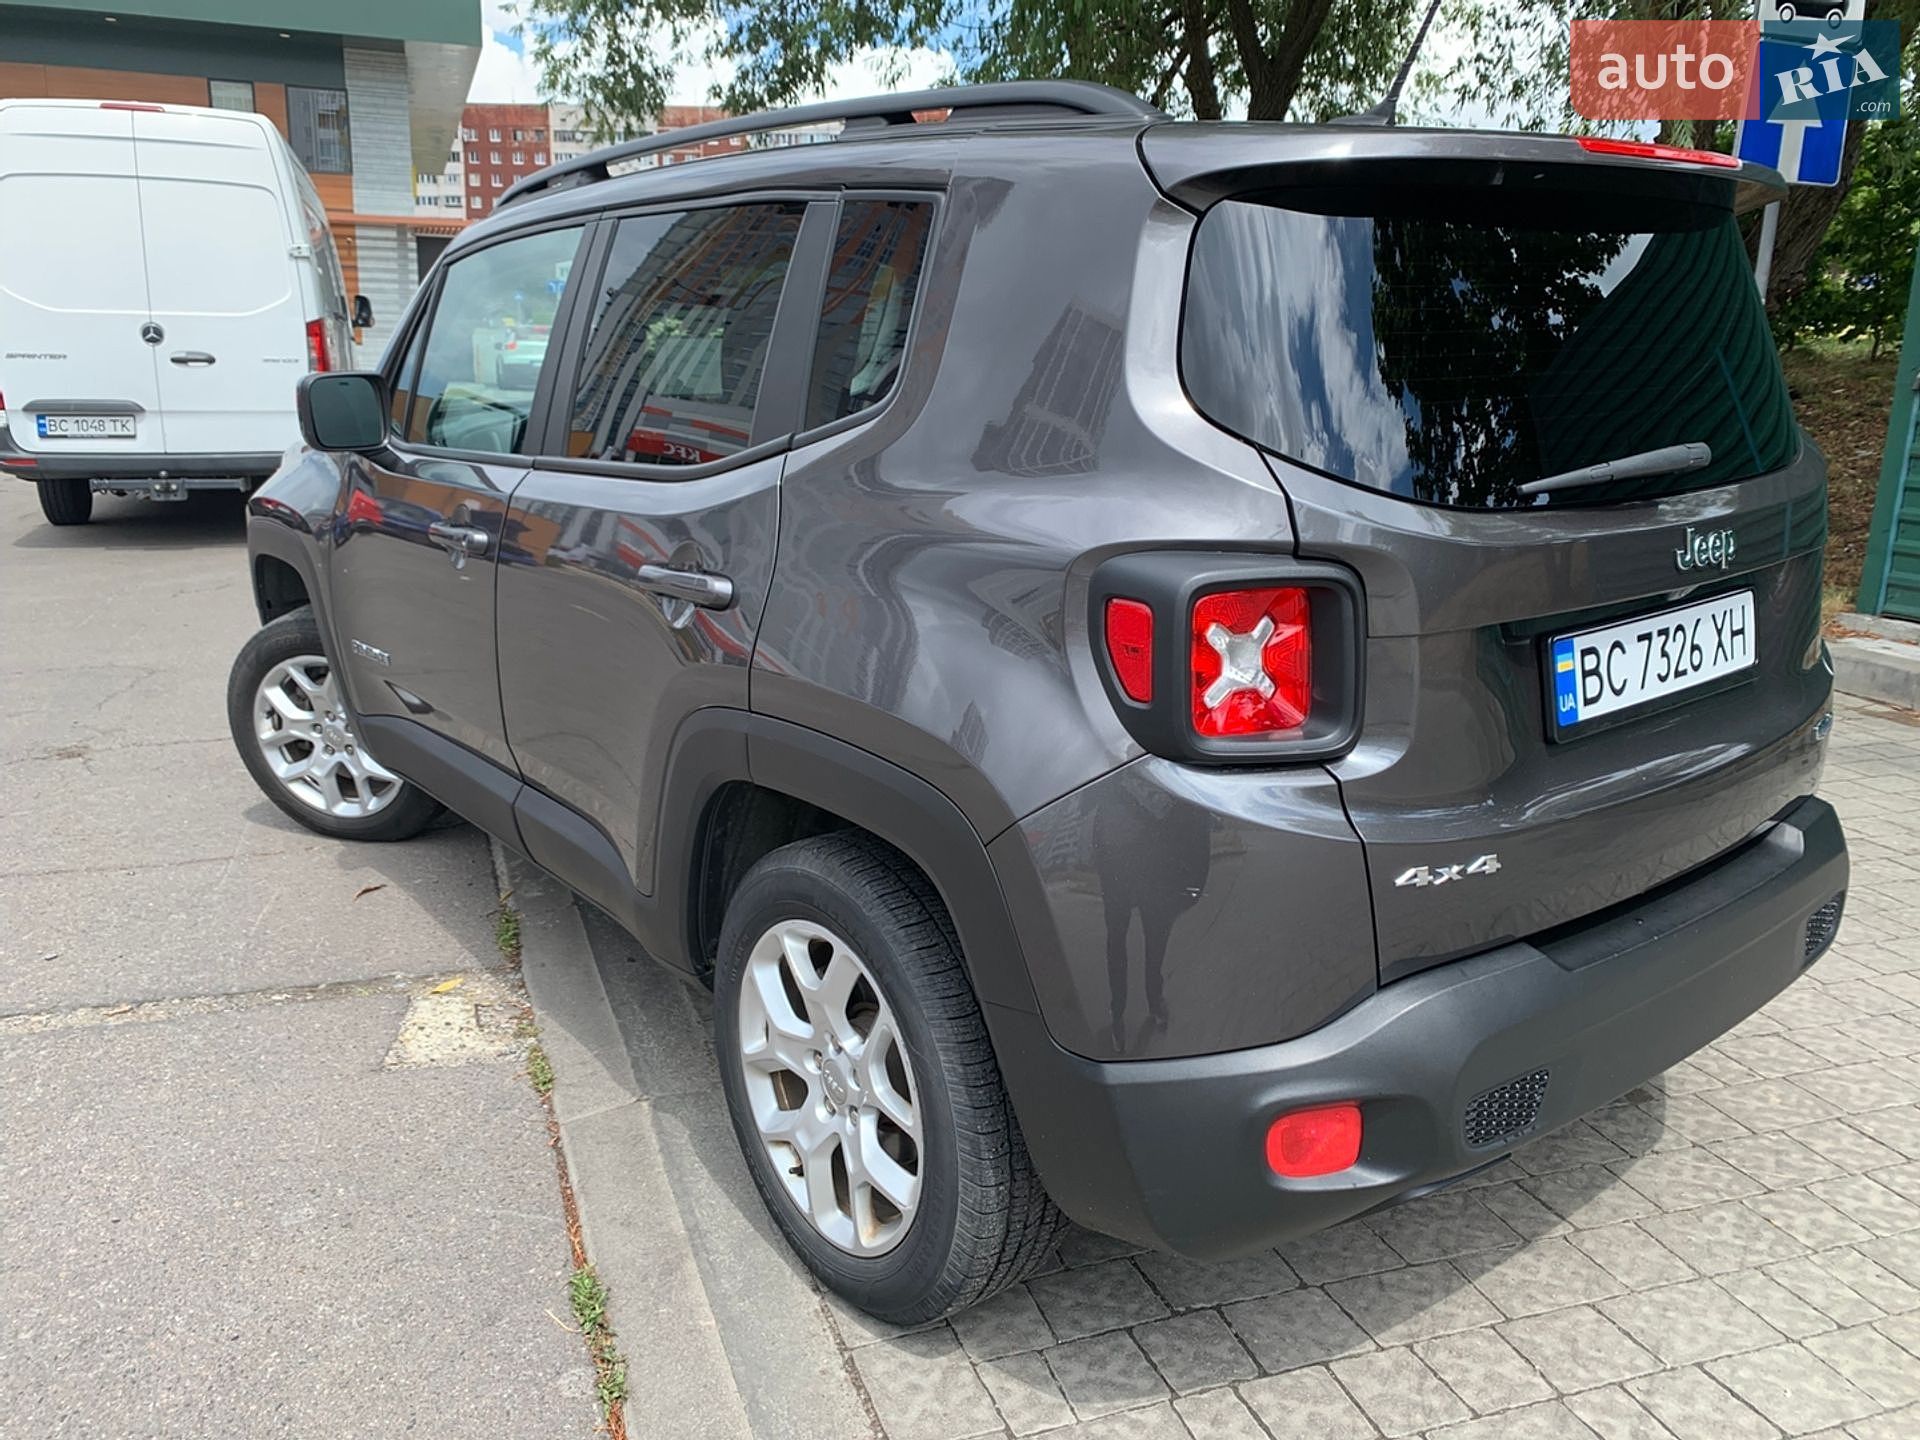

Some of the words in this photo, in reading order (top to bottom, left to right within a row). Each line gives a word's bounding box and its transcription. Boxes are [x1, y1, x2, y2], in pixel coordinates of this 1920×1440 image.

[48, 419, 69, 432] BC
[73, 419, 106, 432] 1048
[110, 419, 131, 432] TK
[1676, 527, 1736, 570] Jeep
[1580, 641, 1628, 707] BC
[1636, 618, 1703, 690] 7326
[1711, 604, 1747, 667] XH
[1559, 692, 1577, 712] UA
[1394, 853, 1502, 887] 4x4
